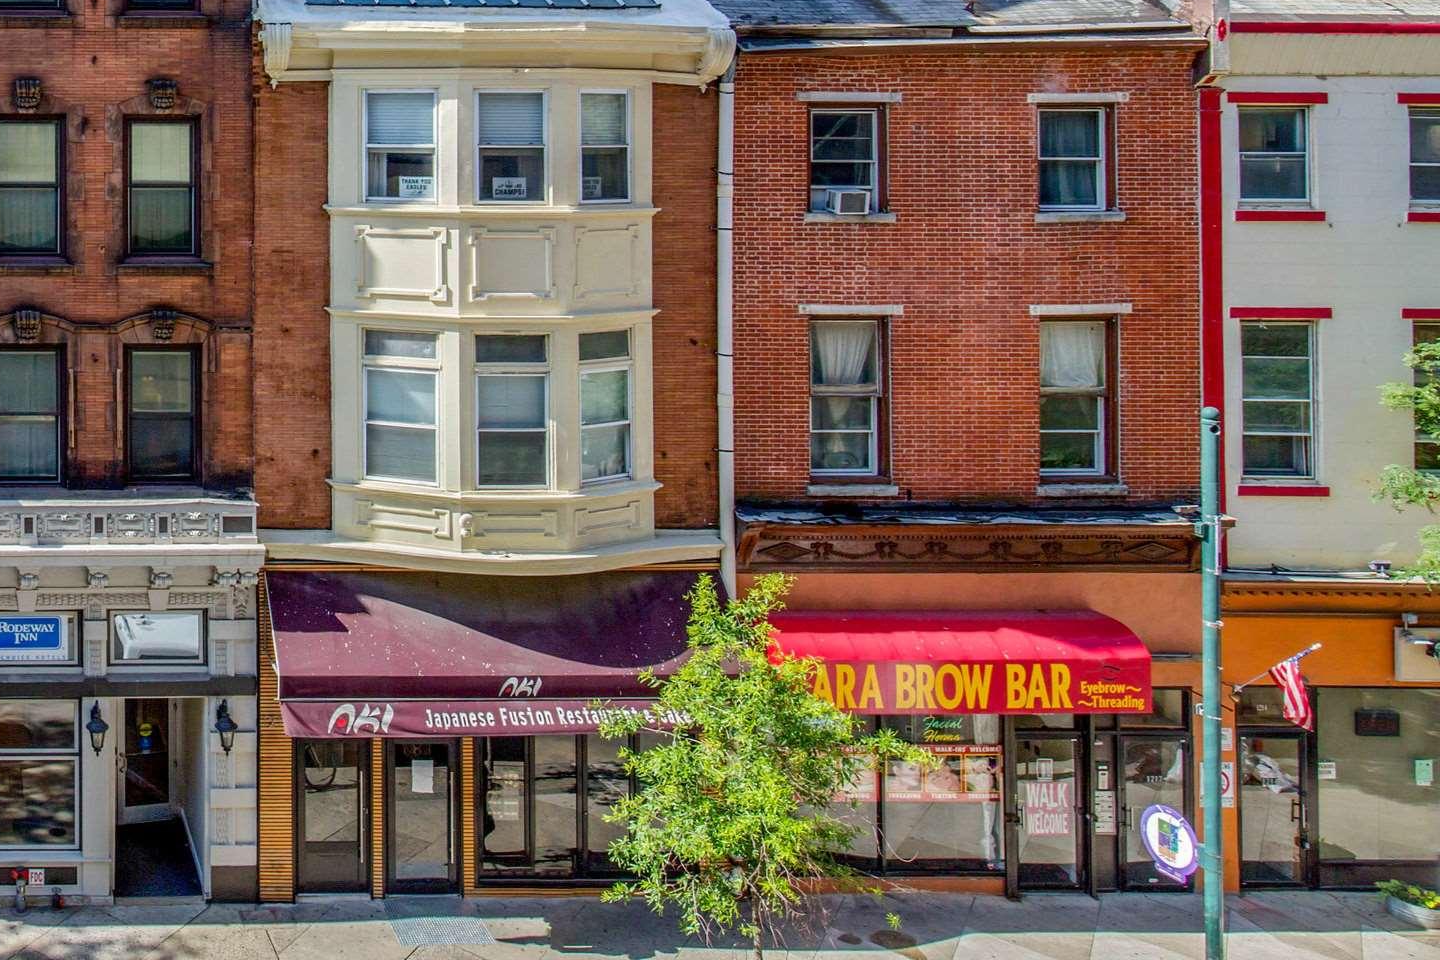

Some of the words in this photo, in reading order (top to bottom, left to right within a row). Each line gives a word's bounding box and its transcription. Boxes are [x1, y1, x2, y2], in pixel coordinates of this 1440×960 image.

[14, 633, 38, 644] INN
[895, 664, 994, 709] BROW
[1006, 663, 1074, 709] BAR
[1080, 681, 1126, 695] Eyebrow
[1091, 696, 1146, 711] Threading
[425, 709, 496, 730] Japanese
[499, 708, 554, 727] Fusion
[1026, 783, 1068, 807] WALK
[1027, 813, 1068, 834] WELCOME
[30, 871, 44, 882] FDC
